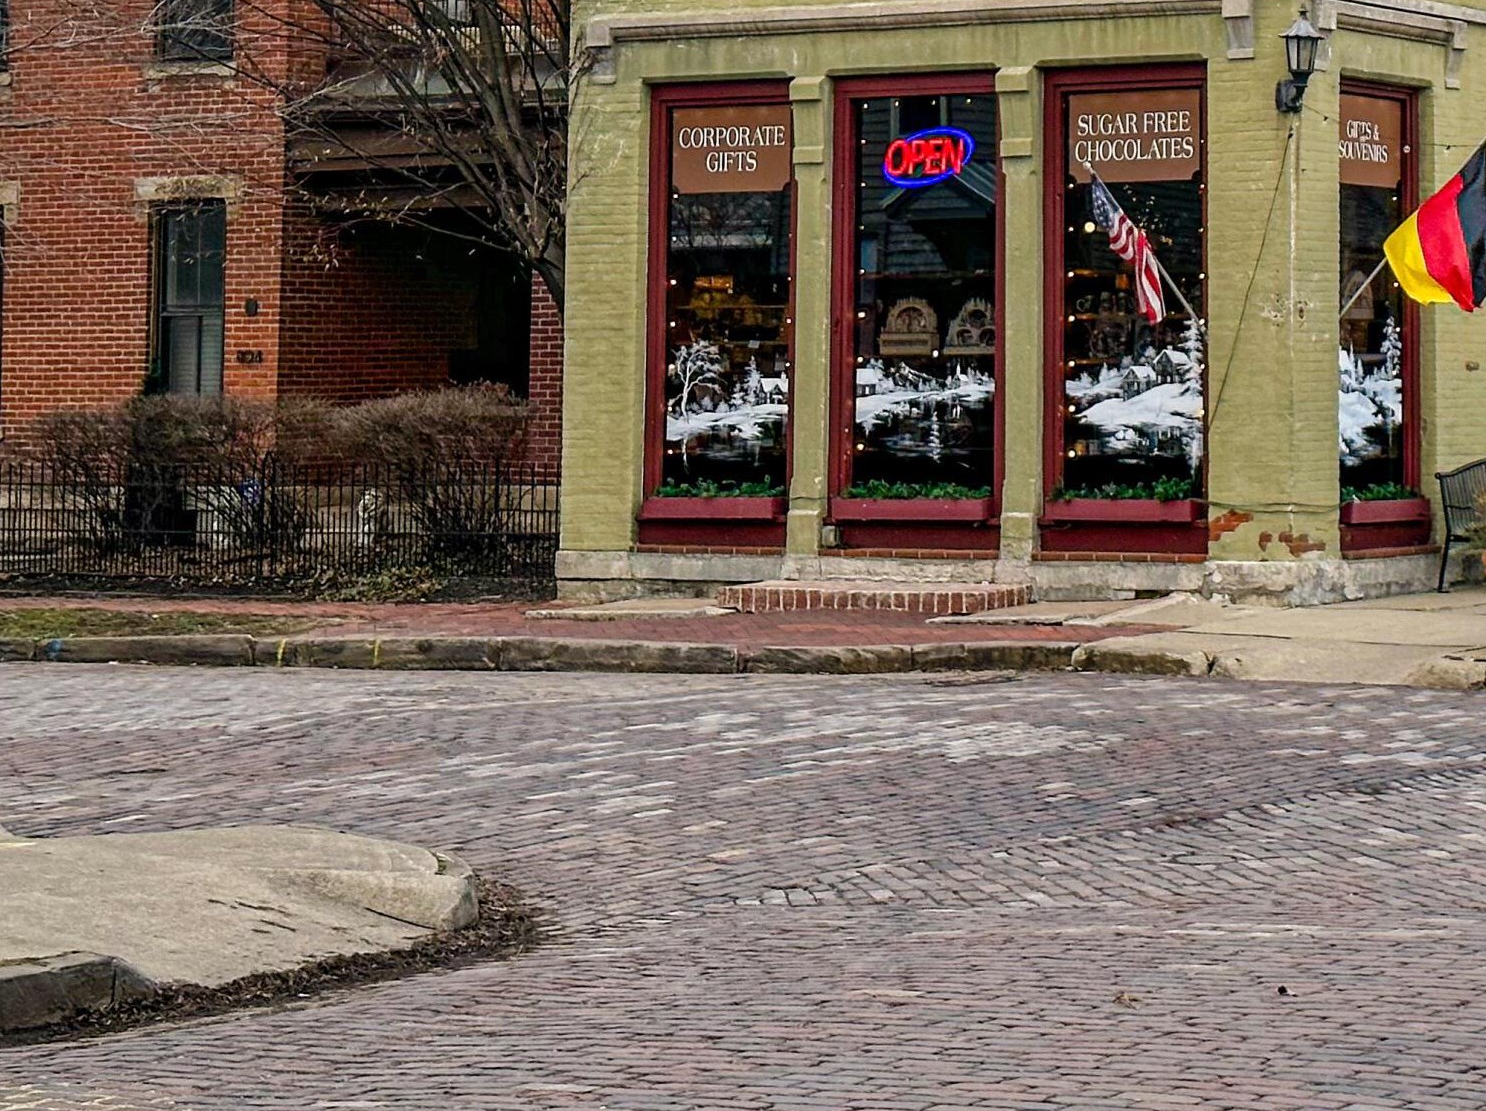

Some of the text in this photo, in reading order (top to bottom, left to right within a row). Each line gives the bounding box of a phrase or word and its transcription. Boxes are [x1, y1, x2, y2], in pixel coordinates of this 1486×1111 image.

[1077, 110, 1192, 137] SUGAR FREE
[1346, 119, 1380, 141] GIFTS &
[679, 125, 786, 149] CORPORATE
[1074, 136, 1194, 162] CHOCOLATES
[706, 150, 758, 173] GIFTS
[884, 137, 964, 177] OPEN
[1338, 139, 1389, 164] SOUVENIRS
